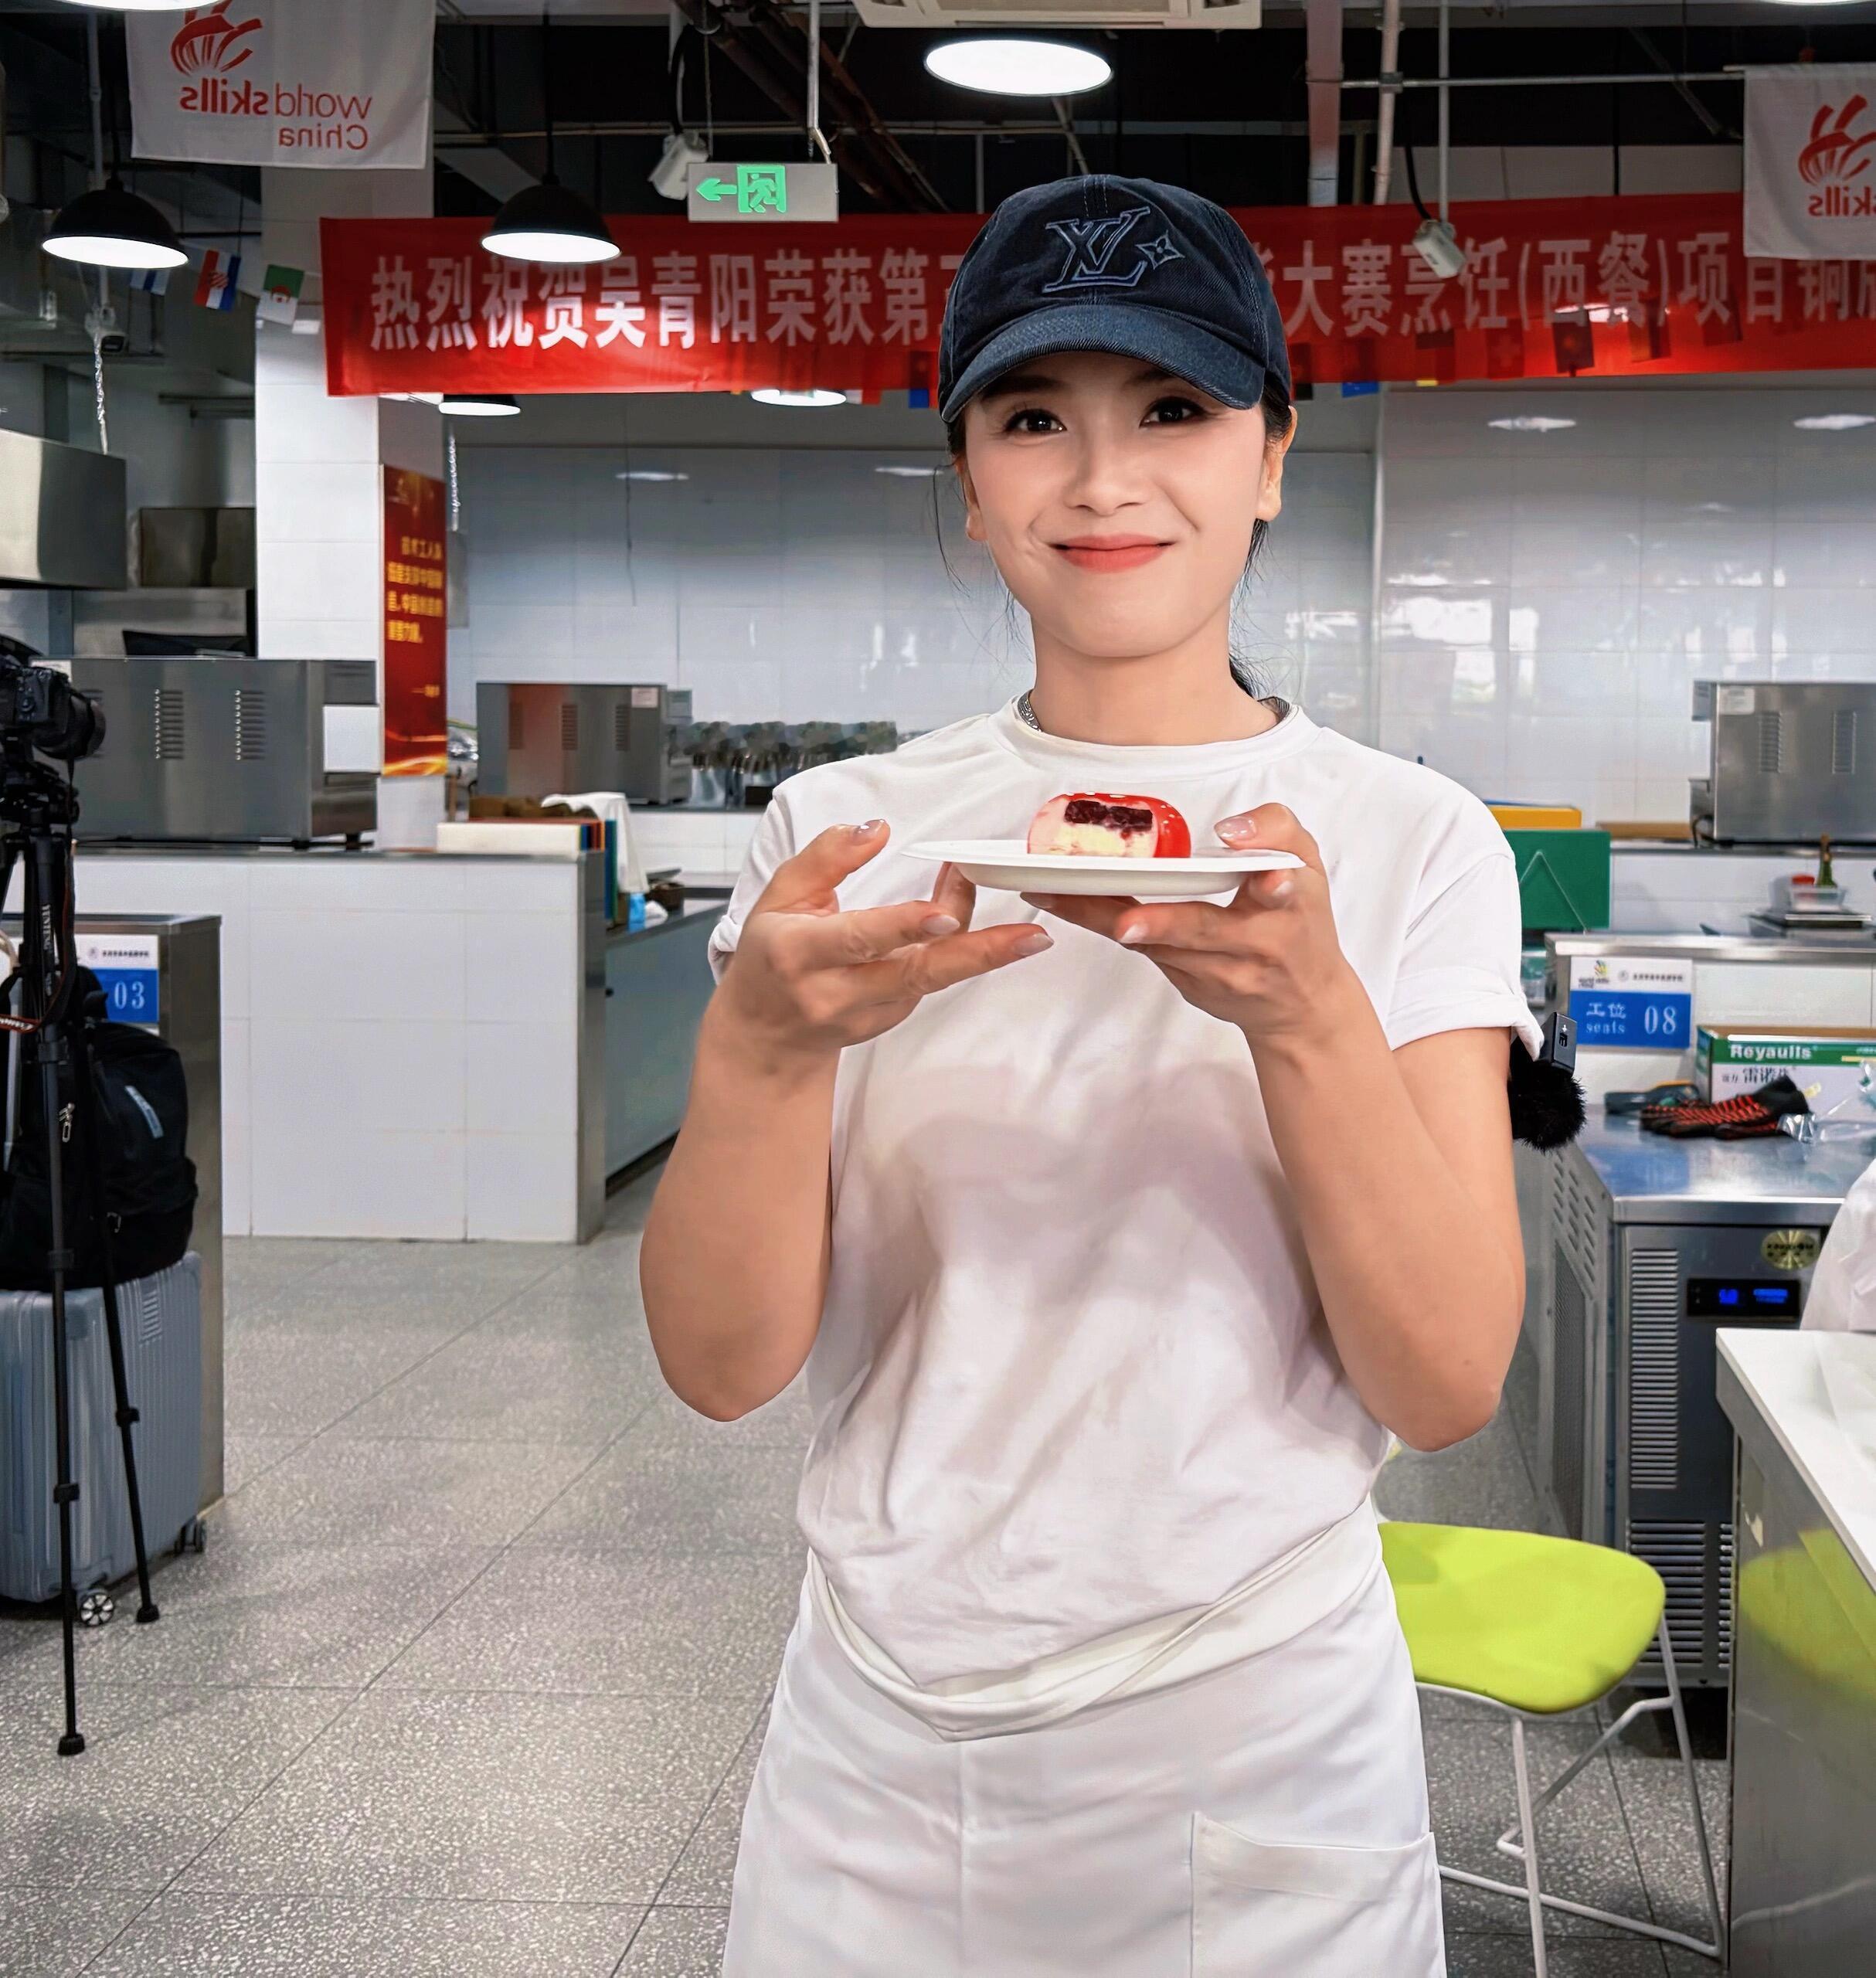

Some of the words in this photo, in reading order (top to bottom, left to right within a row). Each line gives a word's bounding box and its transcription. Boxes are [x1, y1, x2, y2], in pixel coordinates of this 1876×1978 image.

[1253, 231, 1876, 337] 大赛烹饪(西餐)项目铜
[114, 981, 145, 1009] 03
[1586, 1002, 1626, 1019] 工位
[1644, 1005, 1677, 1035] 08
